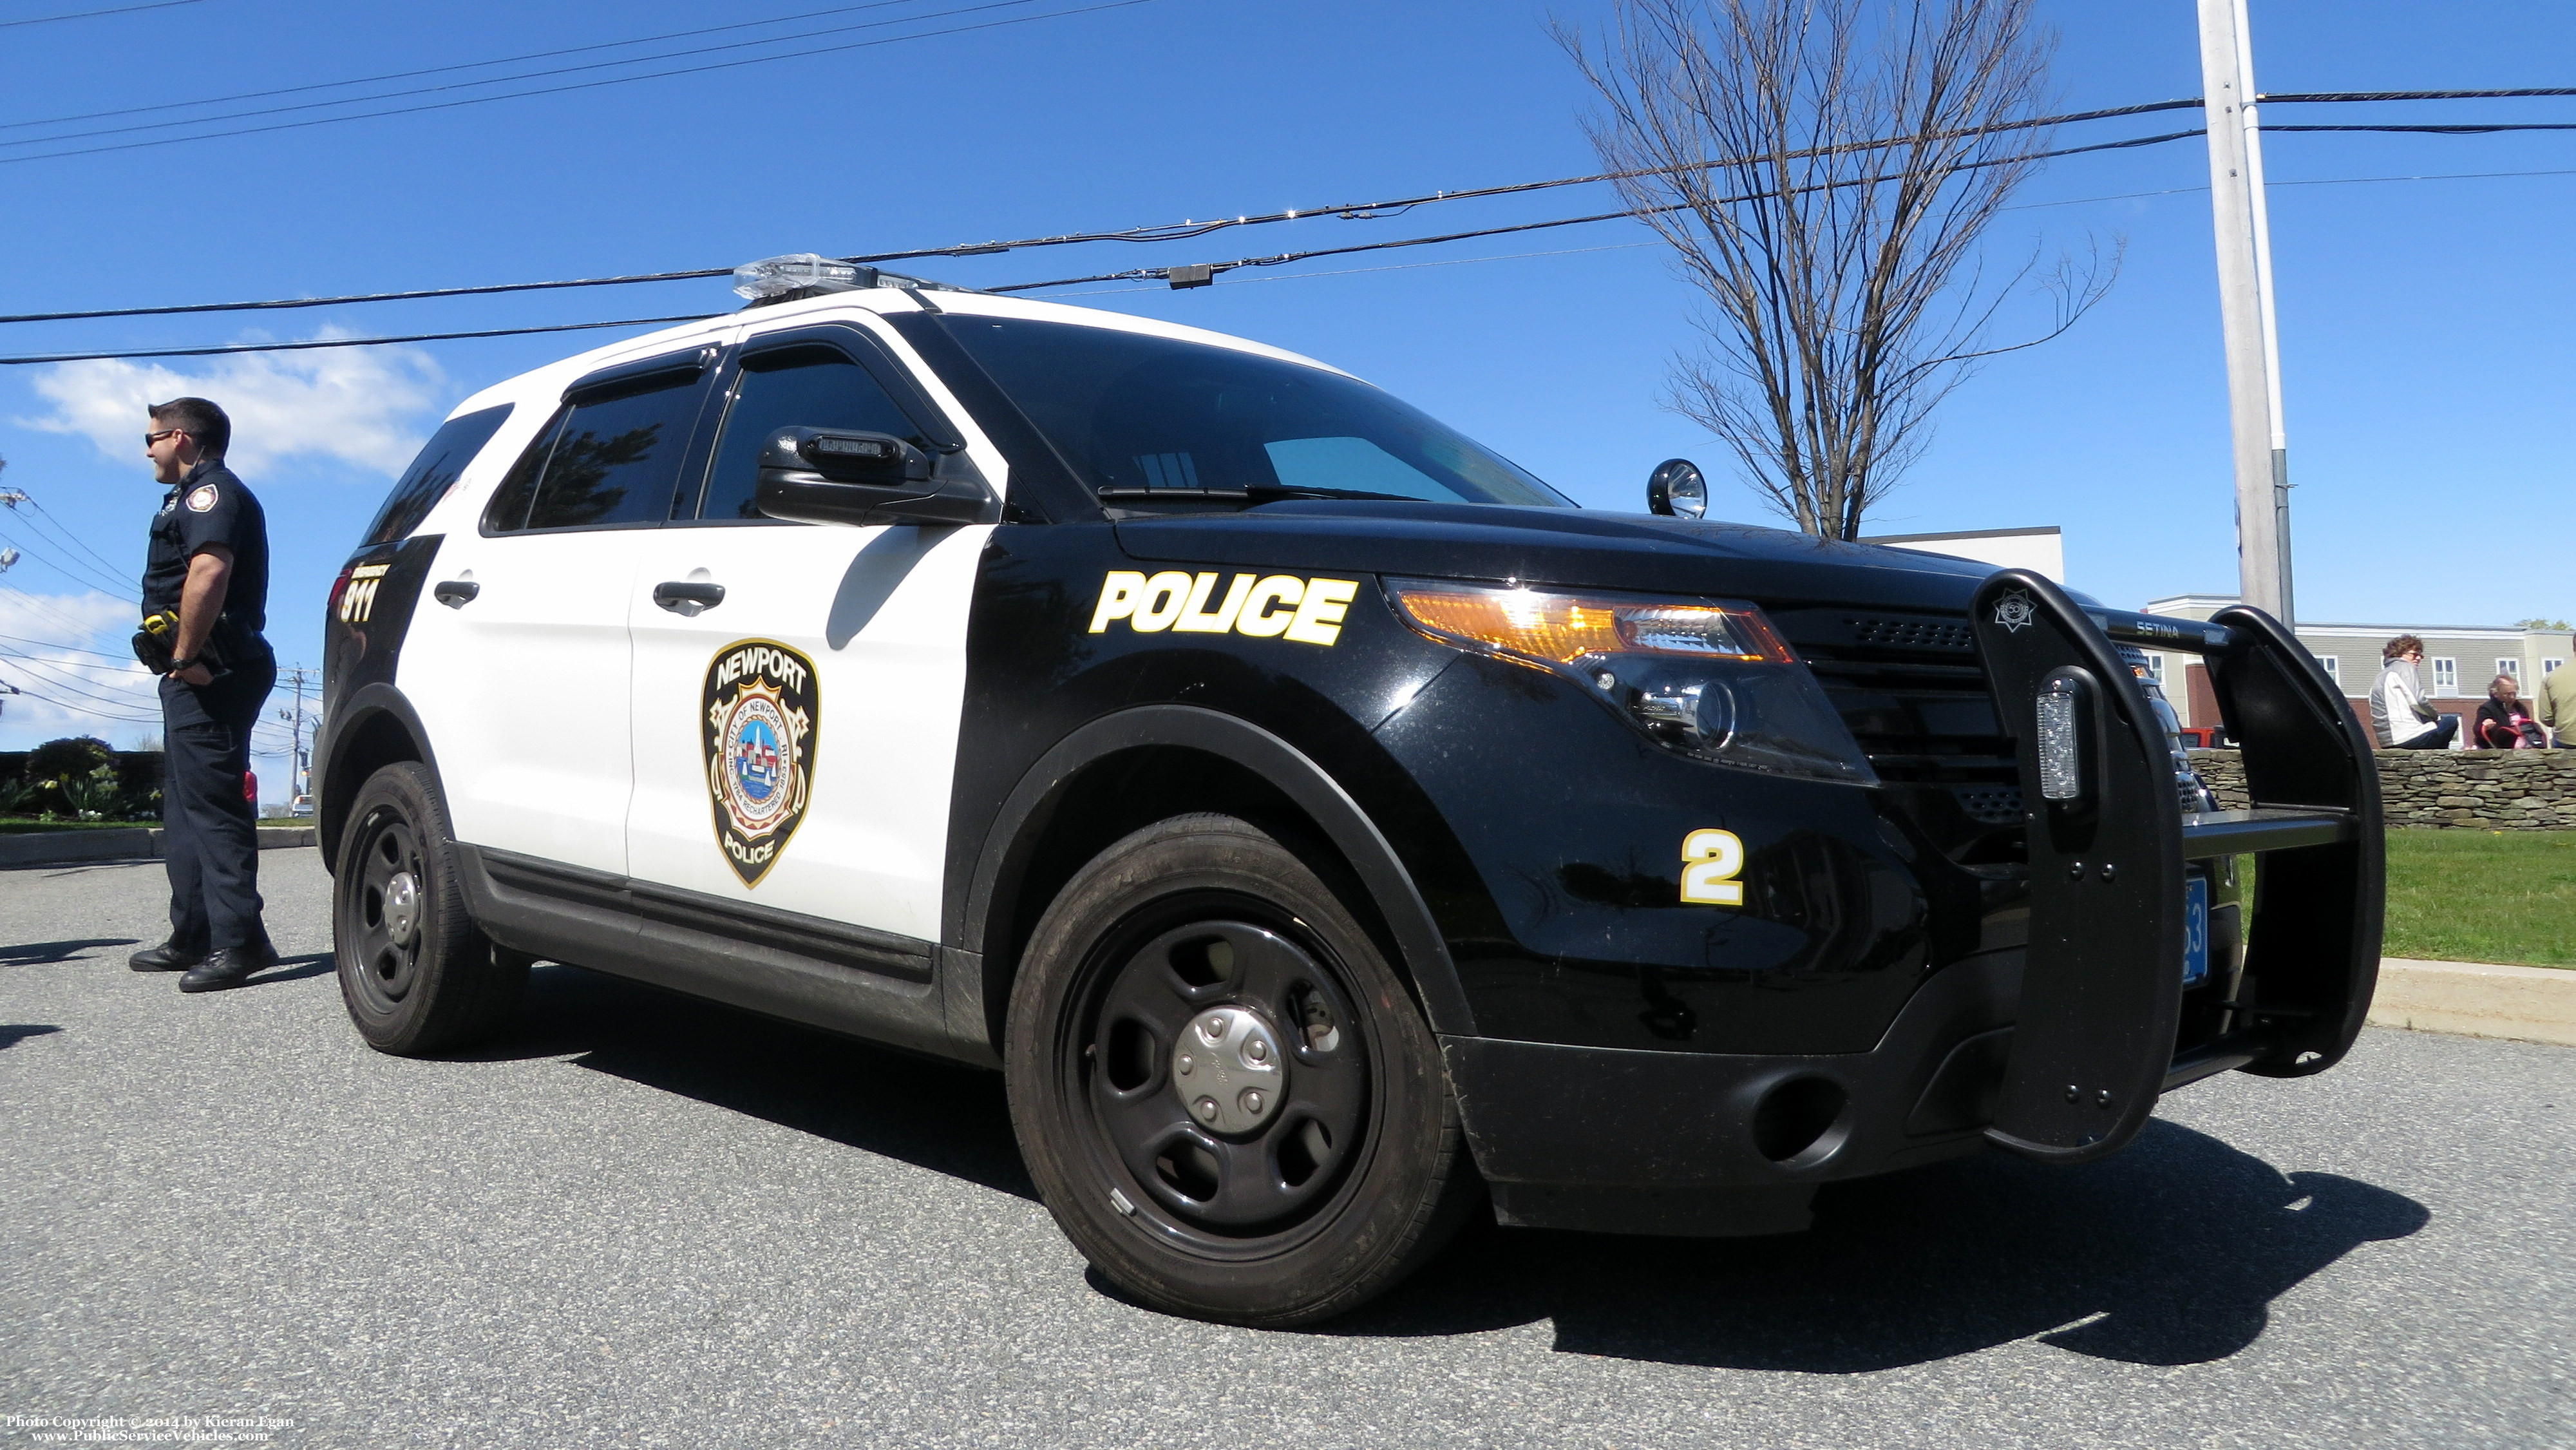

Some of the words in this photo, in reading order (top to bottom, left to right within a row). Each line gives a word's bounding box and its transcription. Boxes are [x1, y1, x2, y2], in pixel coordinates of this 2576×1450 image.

[341, 578, 381, 622] 911
[1088, 571, 1359, 646] POLICE
[2136, 620, 2179, 638] SETINA
[716, 647, 808, 695] NEWPORT
[728, 723, 739, 749] CITY
[738, 706, 748, 721] OF
[750, 701, 783, 730] NEWPORT
[743, 792, 781, 815] RECHARTERED
[724, 831, 775, 864] POLICE
[1680, 828, 1743, 906] 2
